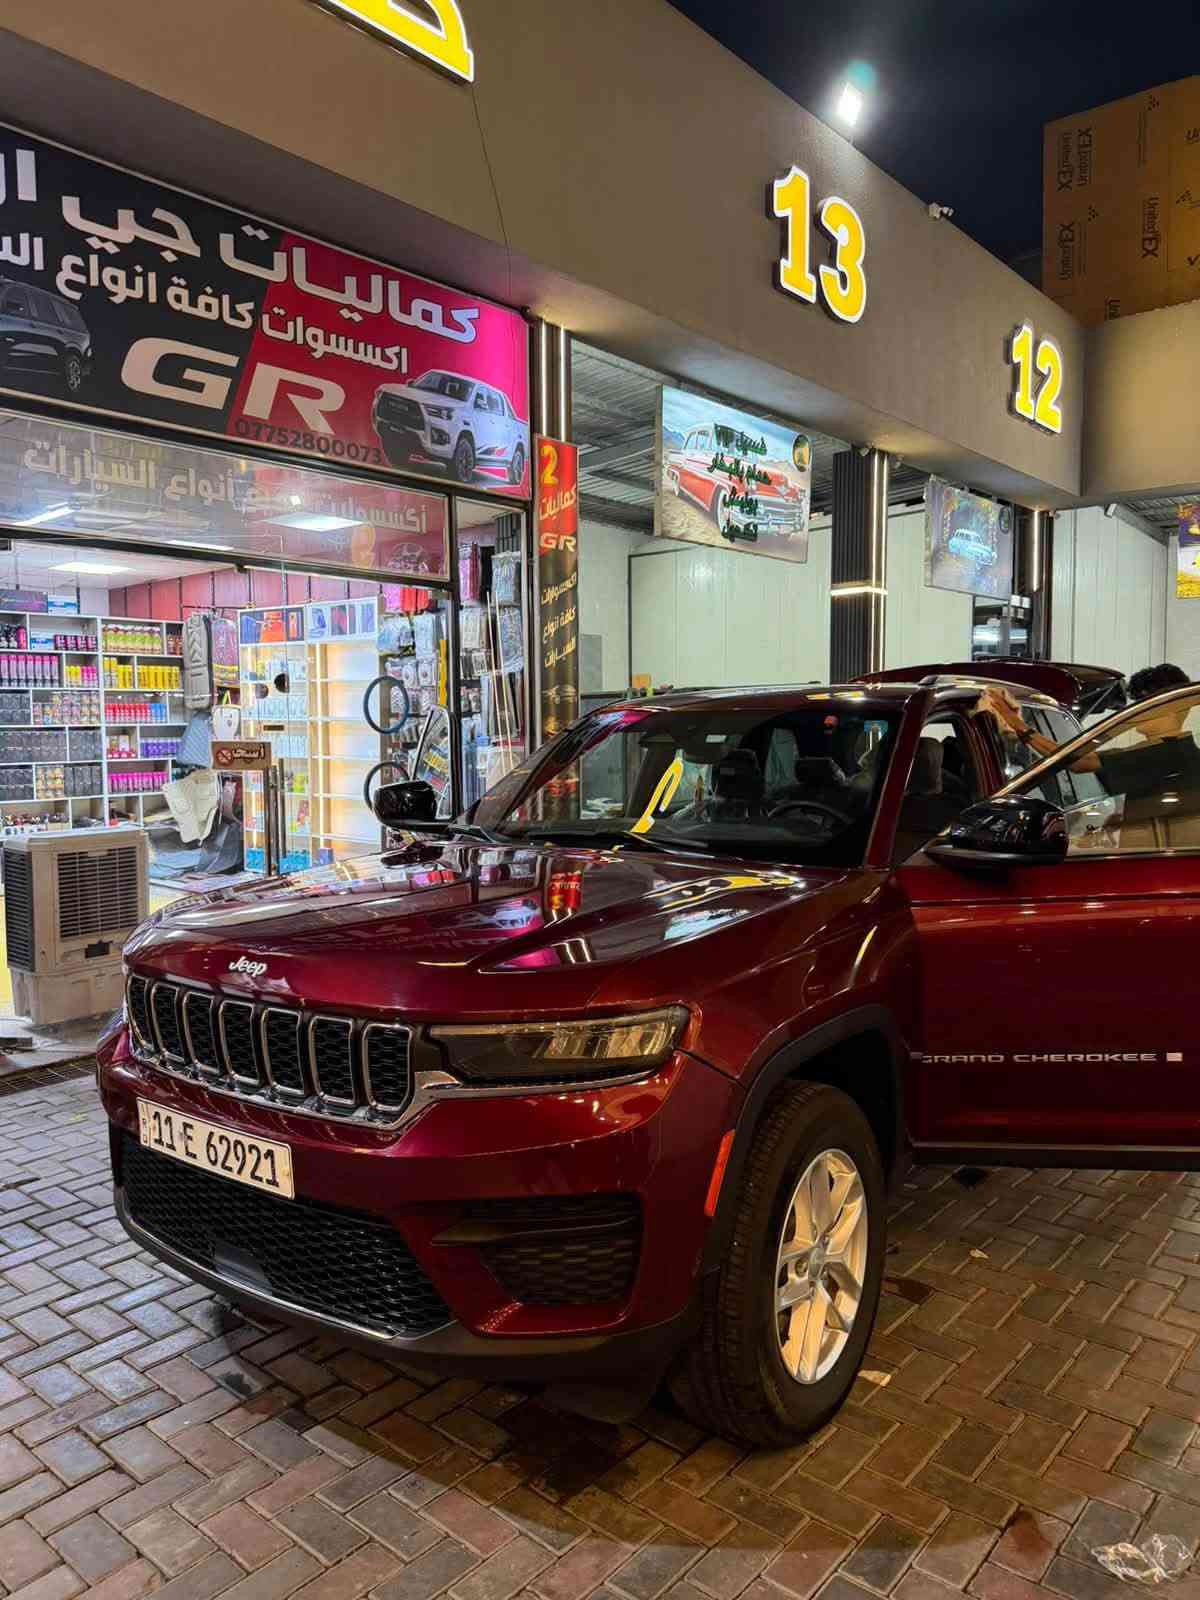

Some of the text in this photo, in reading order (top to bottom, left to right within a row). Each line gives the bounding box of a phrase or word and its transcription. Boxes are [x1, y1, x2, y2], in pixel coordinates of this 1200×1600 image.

[773, 165, 867, 323] 13
[56, 254, 157, 304] انواع
[166, 275, 255, 329] كافة
[219, 224, 480, 344] كماليات
[121, 337, 346, 435] GR
[1012, 324, 1062, 433] 12
[23, 440, 157, 492] السيارات
[234, 417, 383, 465] 07752800073
[540, 445, 558, 485] 2
[540, 532, 577, 552] GR
[228, 956, 268, 976] Jeep
[1013, 1053, 1157, 1063] CHEROKEE
[153, 1111, 176, 1151] 11
[182, 1121, 198, 1160] E
[205, 1131, 280, 1188] 62921
